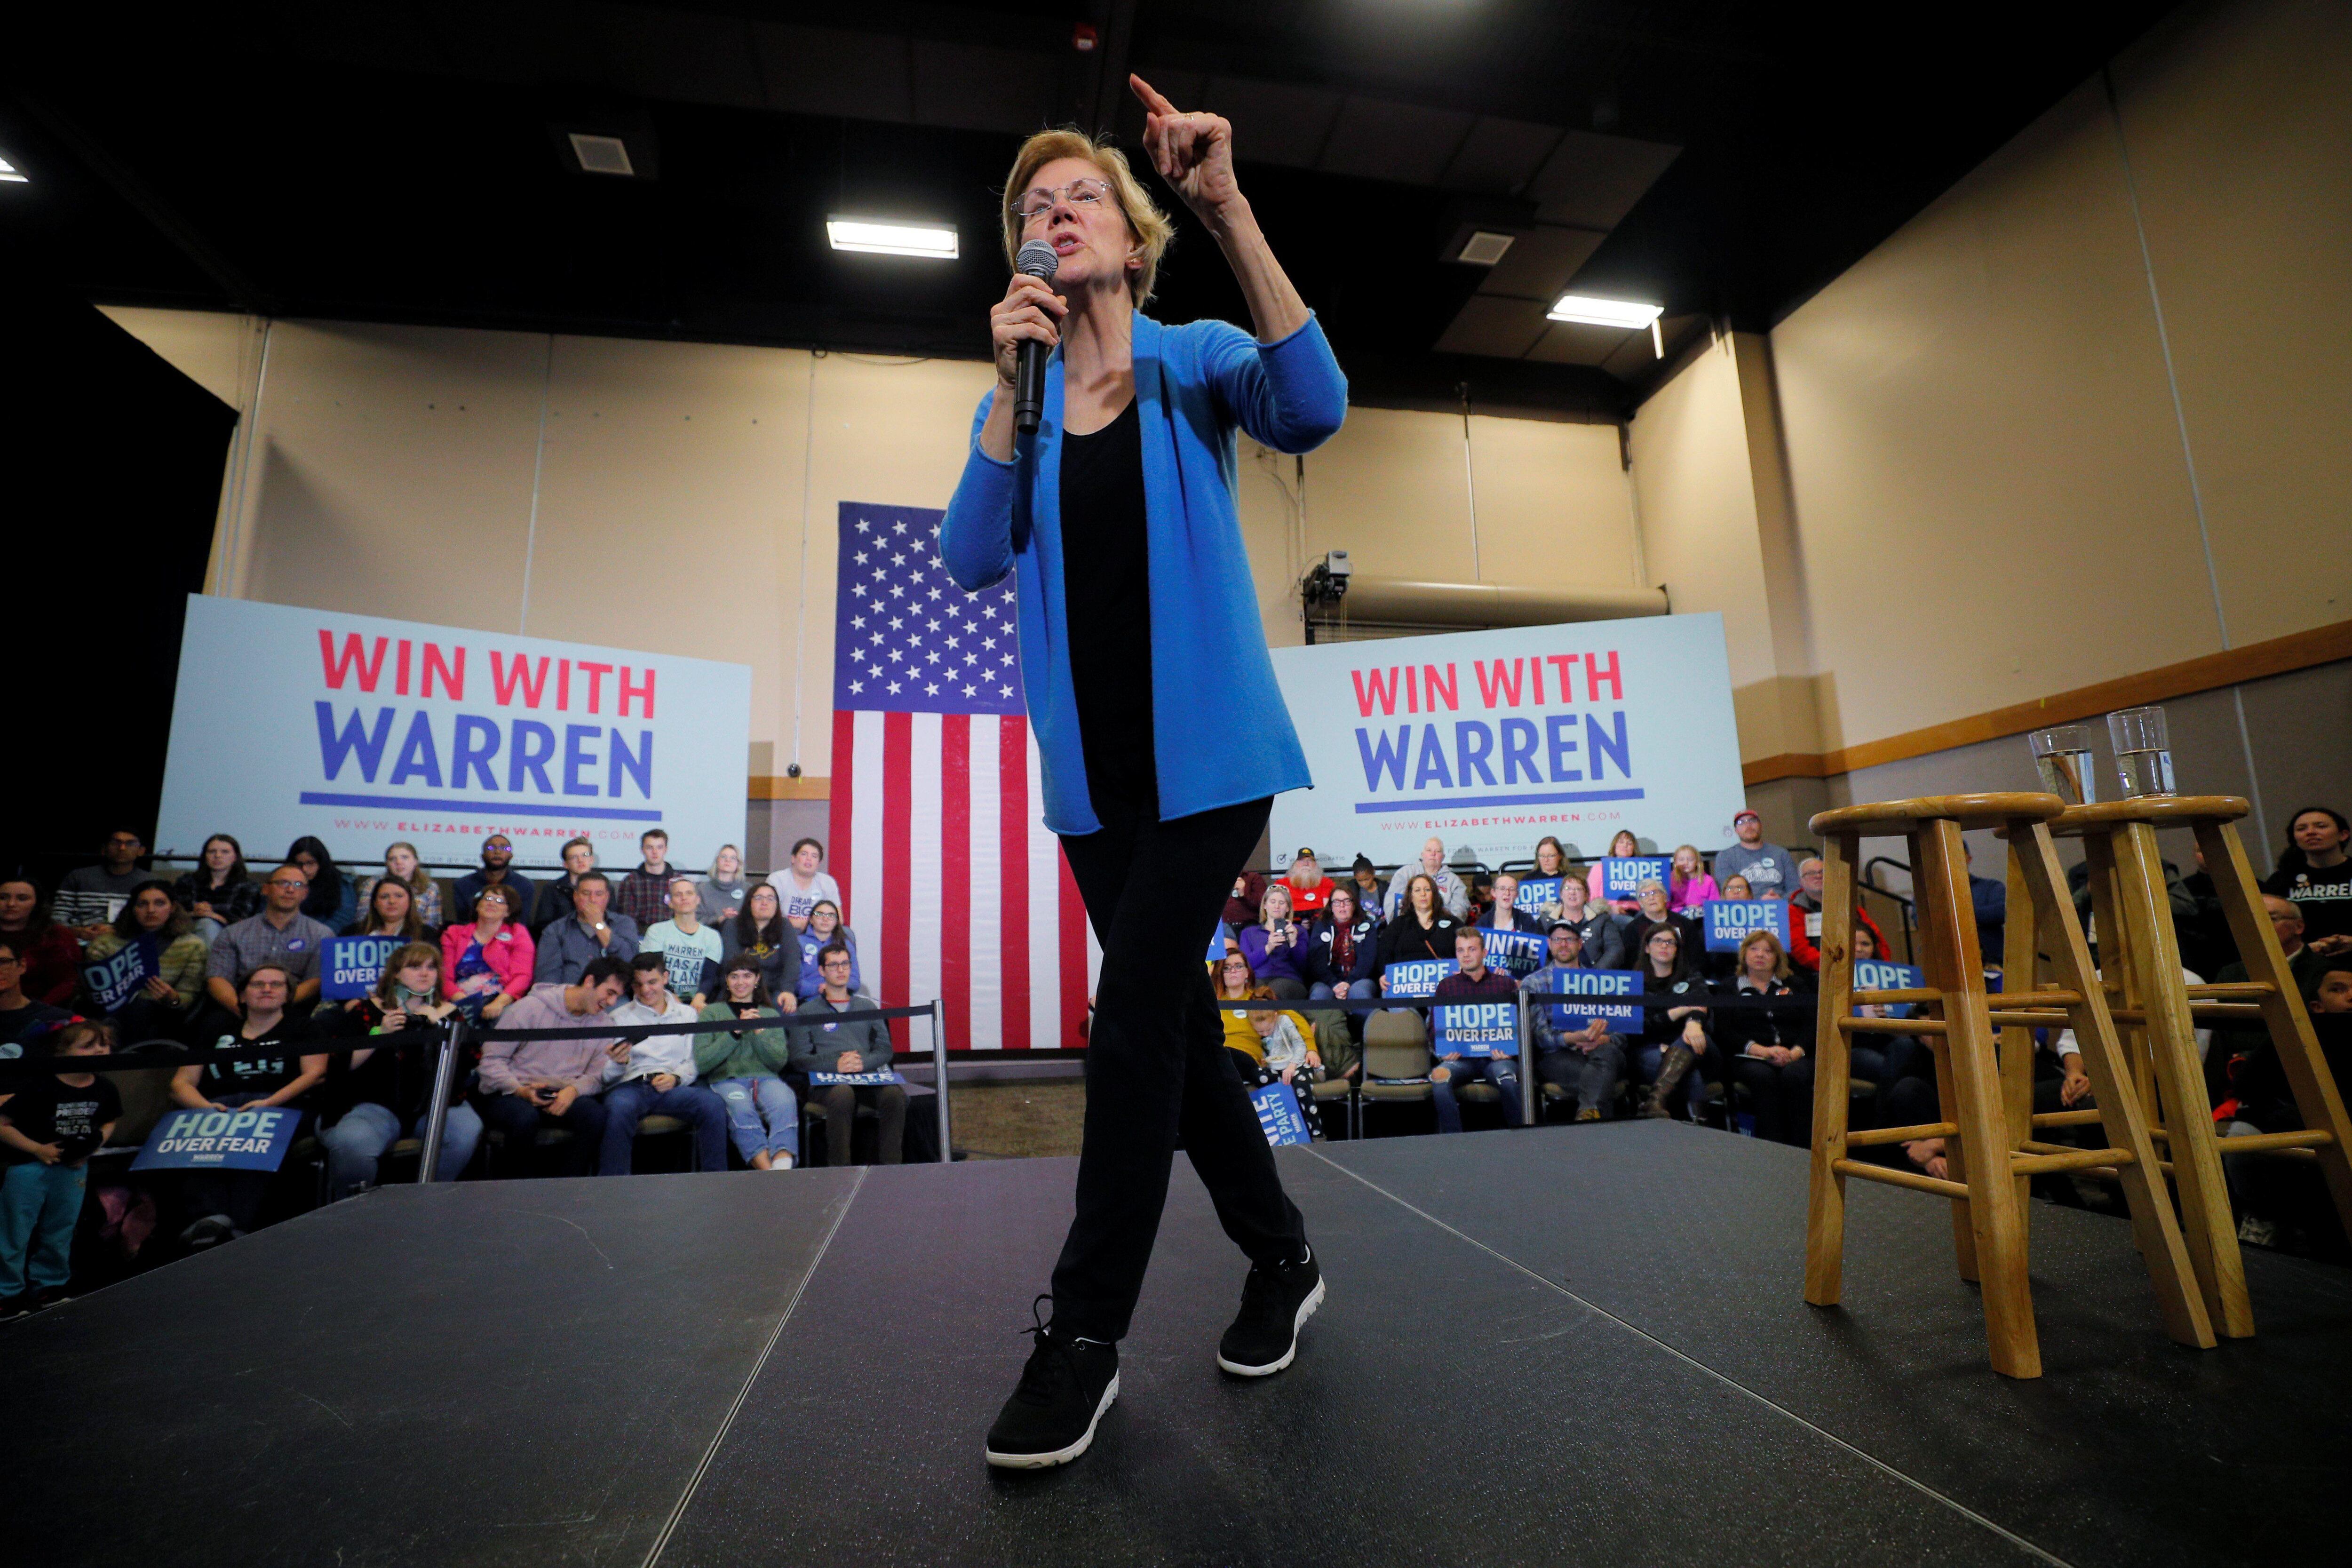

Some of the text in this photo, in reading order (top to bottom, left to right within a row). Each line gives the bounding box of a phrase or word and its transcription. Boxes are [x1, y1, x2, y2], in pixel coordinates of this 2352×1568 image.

[318, 629, 656, 719] WIN WITH
[1351, 651, 1623, 717] WIN WITH
[315, 701, 654, 800] WARREN
[1355, 711, 1632, 792] WARREN
[334, 819, 634, 840] WWW.ELIZABETHWARREN.COM
[1381, 812, 1621, 831] WWW.ELIZABETHWARREN.COM
[1610, 860, 1663, 881] HOPE
[1610, 880, 1637, 891] OVER
[2289, 883, 2352, 898] WARRE
[789, 904, 813, 916] BIG
[1714, 903, 1779, 927] HOPE
[1715, 927, 1747, 939] OVER
[334, 940, 405, 969] HOP
[668, 944, 703, 956] WARREN
[85, 942, 142, 991] OPE
[665, 956, 699, 971] HAS A
[1393, 963, 1450, 984] HOPE
[1500, 955, 1538, 972] PARTY
[116, 964, 145, 996] FEAR
[334, 967, 376, 984] OVER
[671, 970, 697, 984] LAN
[1564, 973, 1631, 996] HOPE
[1392, 982, 1422, 995] OVER
[1445, 1003, 1512, 1029] HOPE
[1563, 1003, 1632, 1018] OVER FEAR
[1446, 1027, 1513, 1043] OVER FEAR
[1267, 1092, 1293, 1136] PARTY
[166, 1111, 283, 1139] HOPE
[157, 1137, 271, 1154] OVER FEAR
